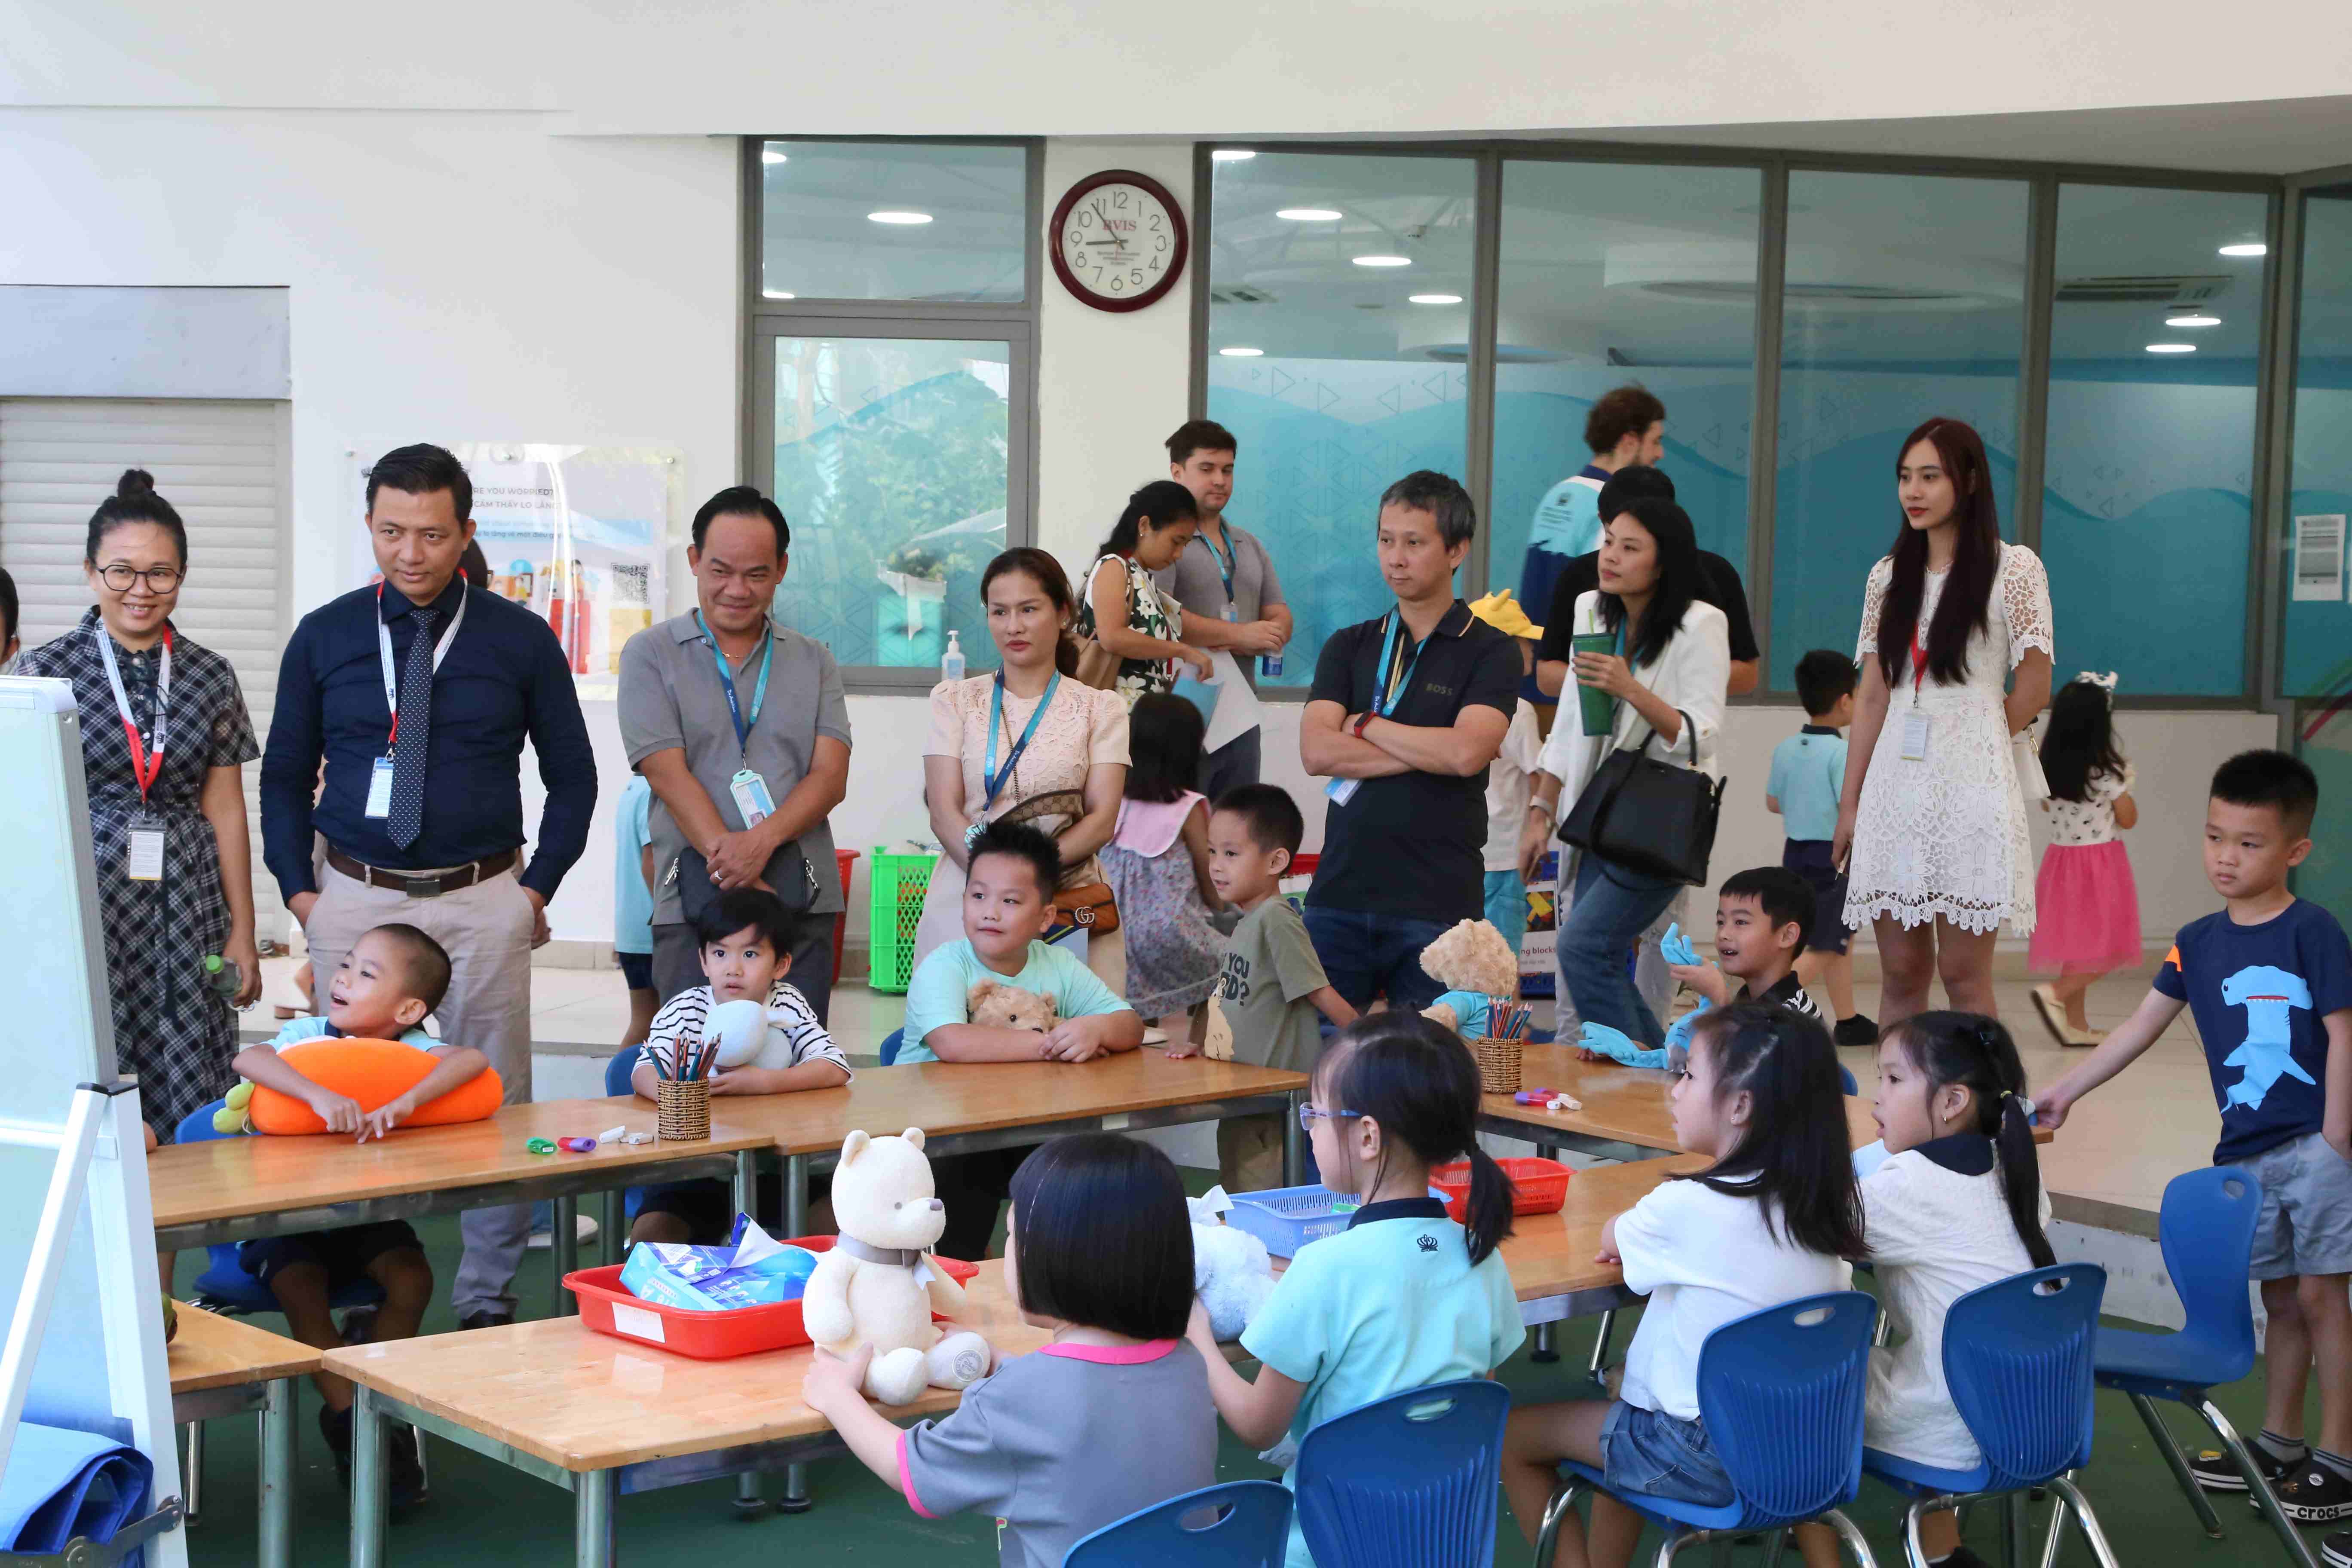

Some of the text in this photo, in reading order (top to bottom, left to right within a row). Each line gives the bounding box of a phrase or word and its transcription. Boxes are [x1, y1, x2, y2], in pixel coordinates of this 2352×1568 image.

[1096, 199, 1106, 214] 11
[1114, 192, 1128, 209] 12
[1138, 200, 1142, 217] 1
[1078, 211, 1092, 227] 10
[1149, 214, 1160, 231] 2
[1070, 231, 1083, 247] 9
[1155, 235, 1166, 251] 3
[1075, 251, 1087, 267] 8
[1148, 255, 1159, 271] 4
[1092, 266, 1103, 283] 7
[1131, 268, 1143, 285] 5
[1110, 275, 1123, 291] 6
[1228, 952, 1250, 979] YOU
[2297, 1506, 2340, 1519] crocs
